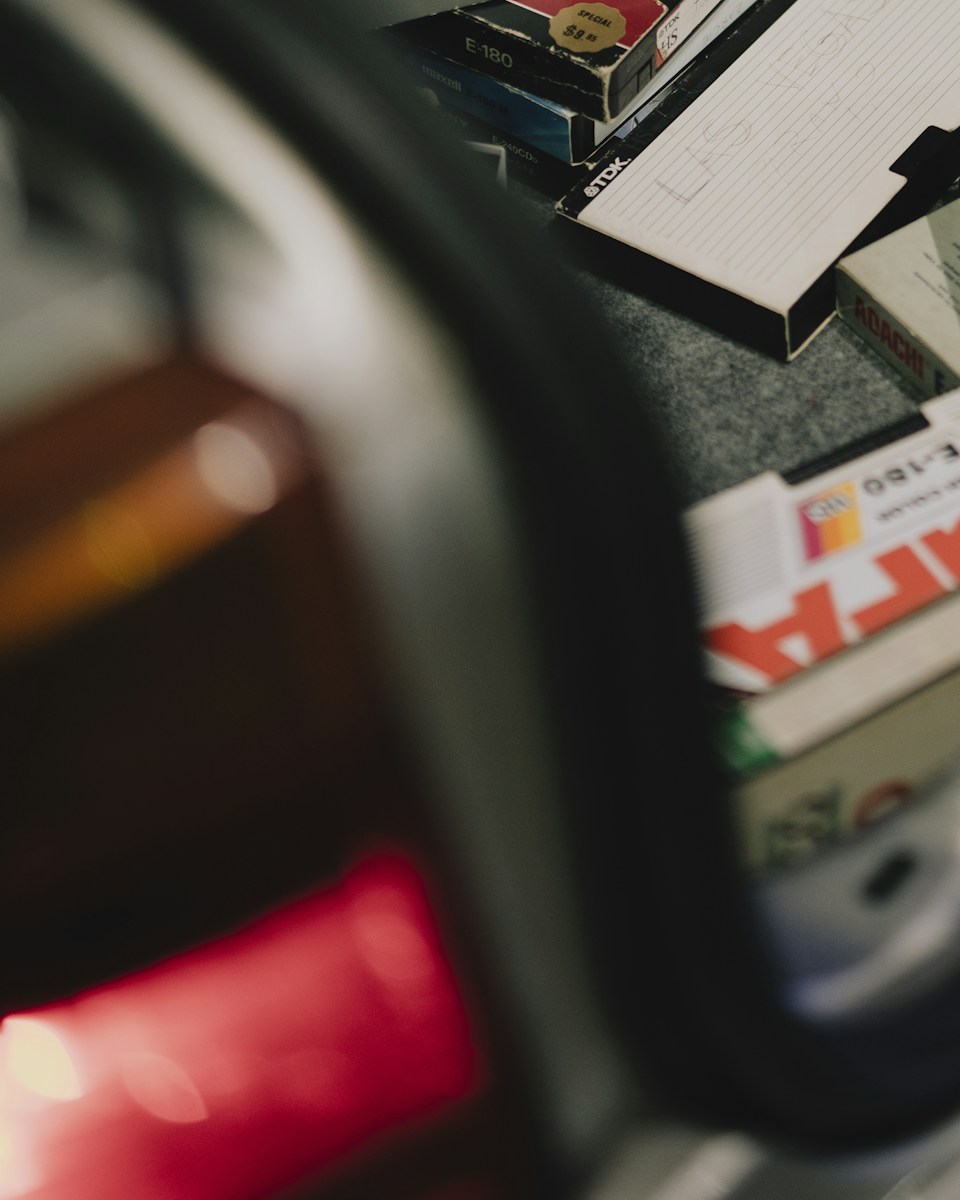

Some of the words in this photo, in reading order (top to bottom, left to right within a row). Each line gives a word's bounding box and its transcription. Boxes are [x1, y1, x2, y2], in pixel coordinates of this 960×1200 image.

[577, 9, 613, 29] SPECIAL
[663, 12, 681, 32] TDK
[465, 36, 514, 69] E-180
[660, 28, 679, 51] HS
[421, 64, 462, 93] maxell
[589, 156, 630, 188] TDK
